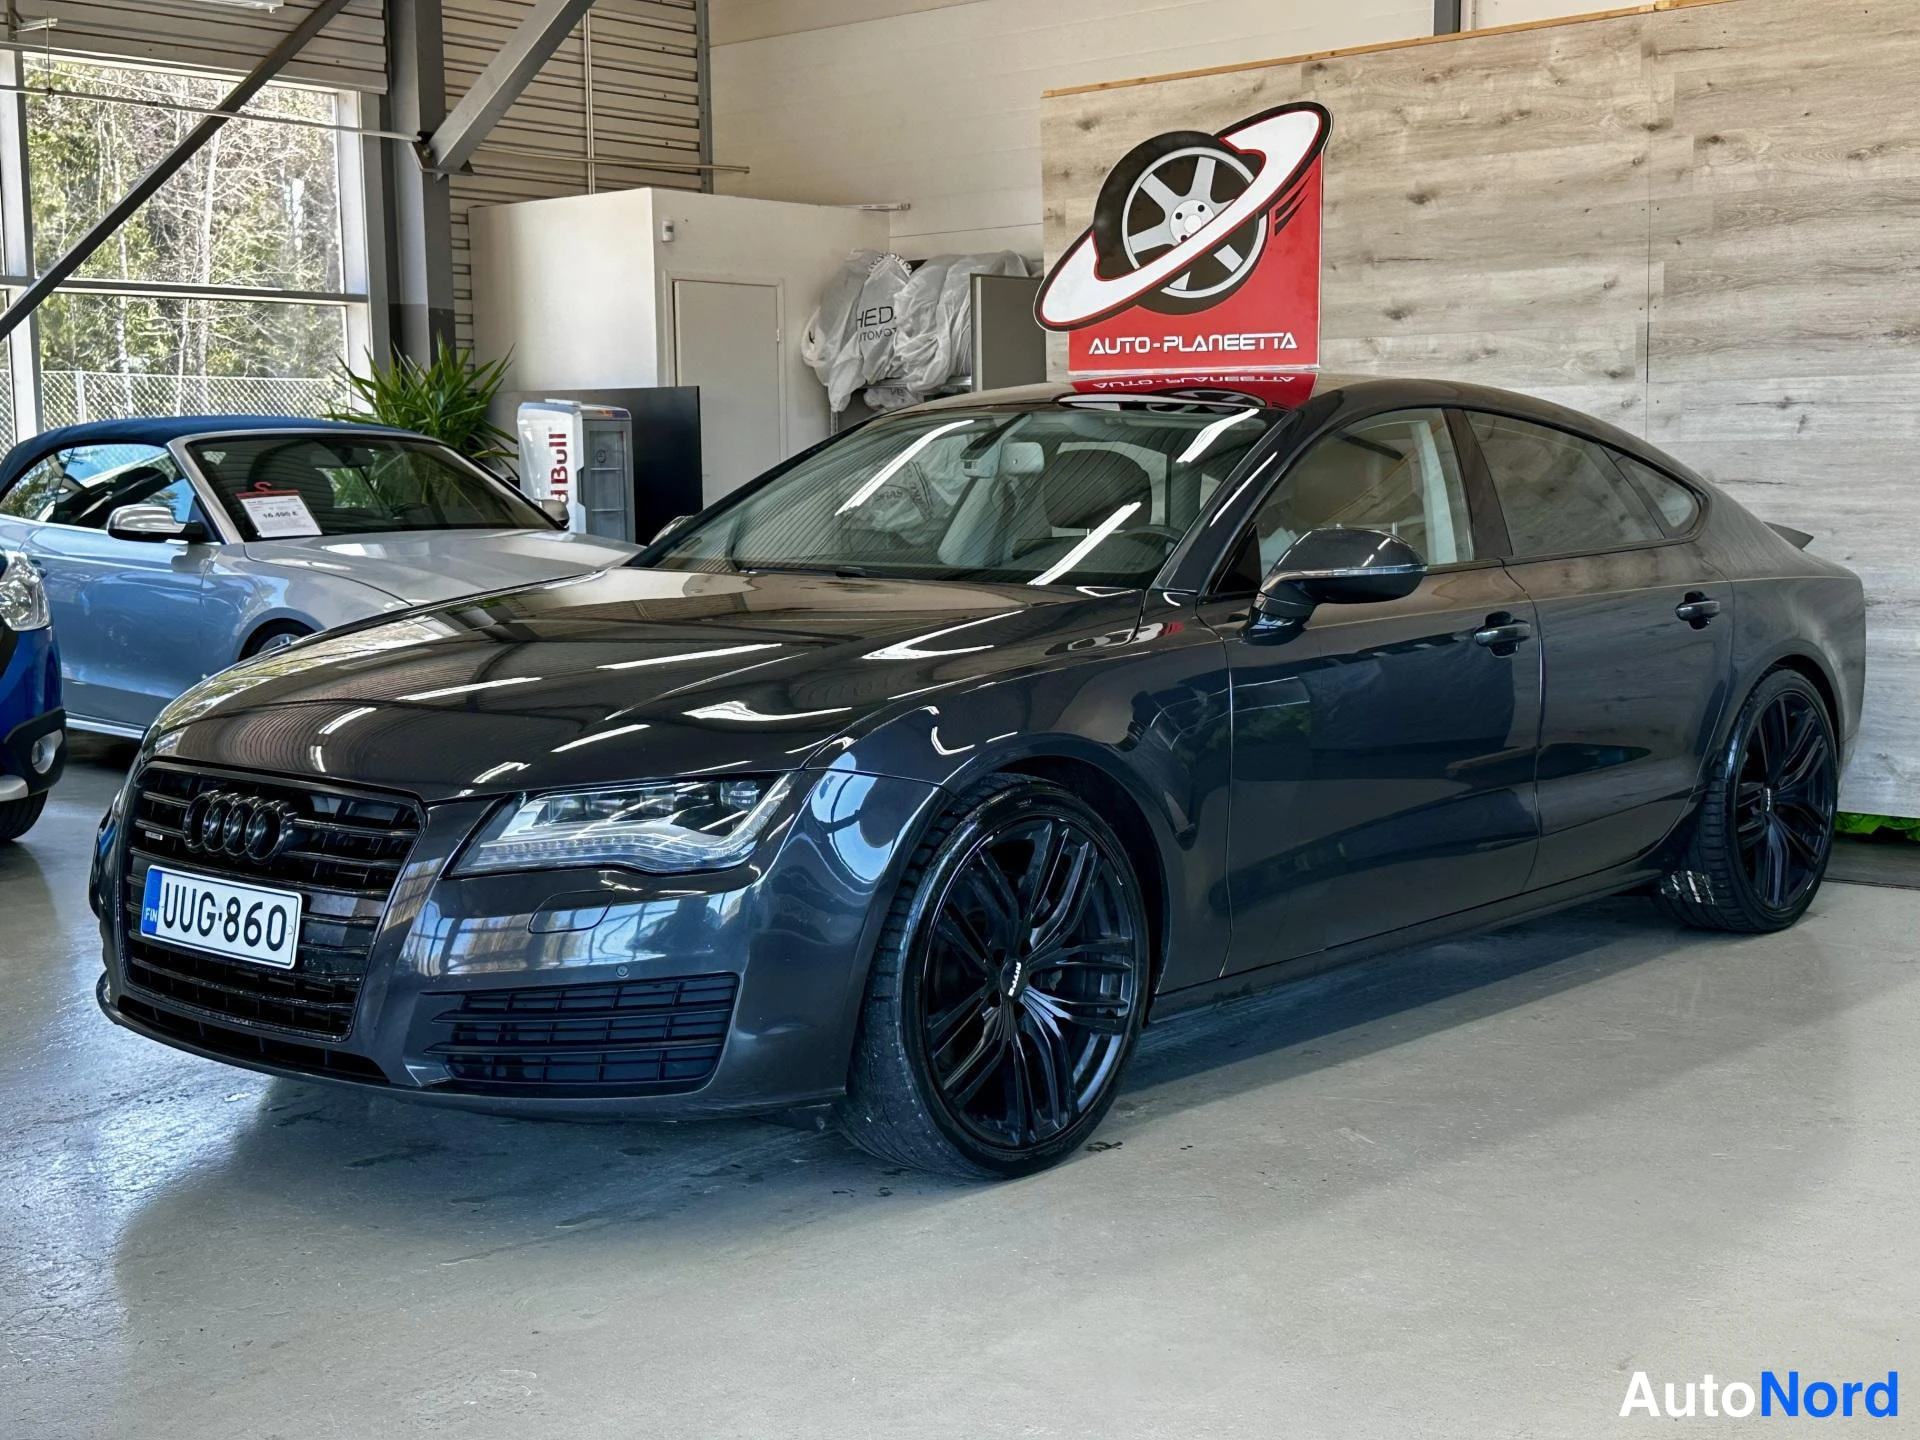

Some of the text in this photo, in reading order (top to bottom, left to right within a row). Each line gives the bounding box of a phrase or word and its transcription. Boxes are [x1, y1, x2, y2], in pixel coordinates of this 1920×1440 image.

[1089, 332, 1298, 354] AUTO-PLANEETTA
[548, 433, 568, 484] Bull
[144, 907, 158, 922] FIN
[163, 882, 287, 951] UUG-860
